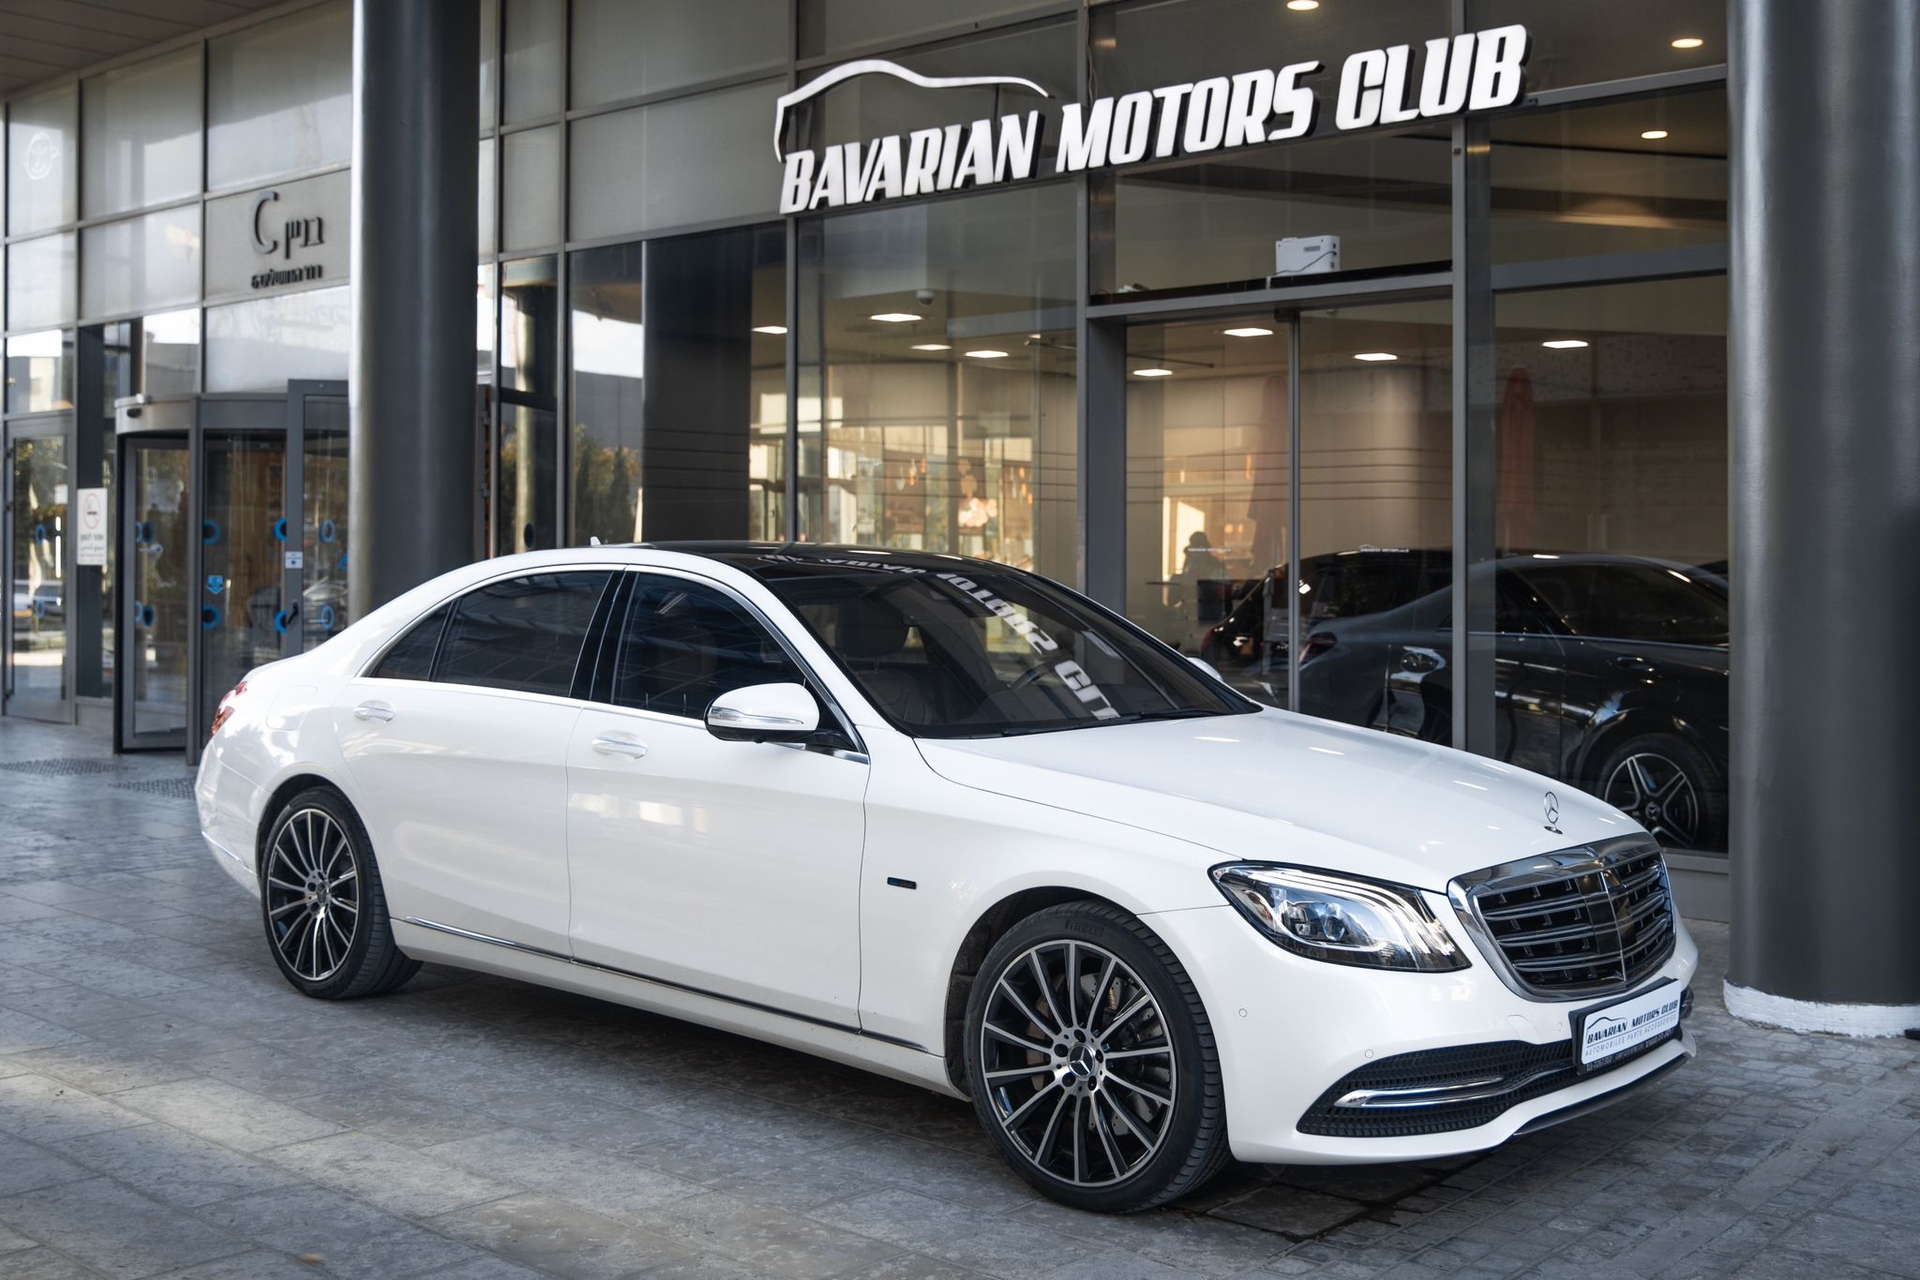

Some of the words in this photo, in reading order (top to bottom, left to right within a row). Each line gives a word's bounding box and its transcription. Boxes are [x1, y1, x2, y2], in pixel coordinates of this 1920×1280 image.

[779, 109, 1042, 215] BAVARIAN
[1055, 60, 1321, 173] MOTORS
[1335, 23, 1528, 131] CLUB
[251, 190, 280, 255] C
[1585, 1037, 1625, 1056] AUTOMOBILES
[1627, 1030, 1643, 1041] PARTS
[1587, 1022, 1628, 1045] BAVARIAN
[1631, 1007, 1661, 1028] MOTORS
[1660, 999, 1679, 1015] CLUB
